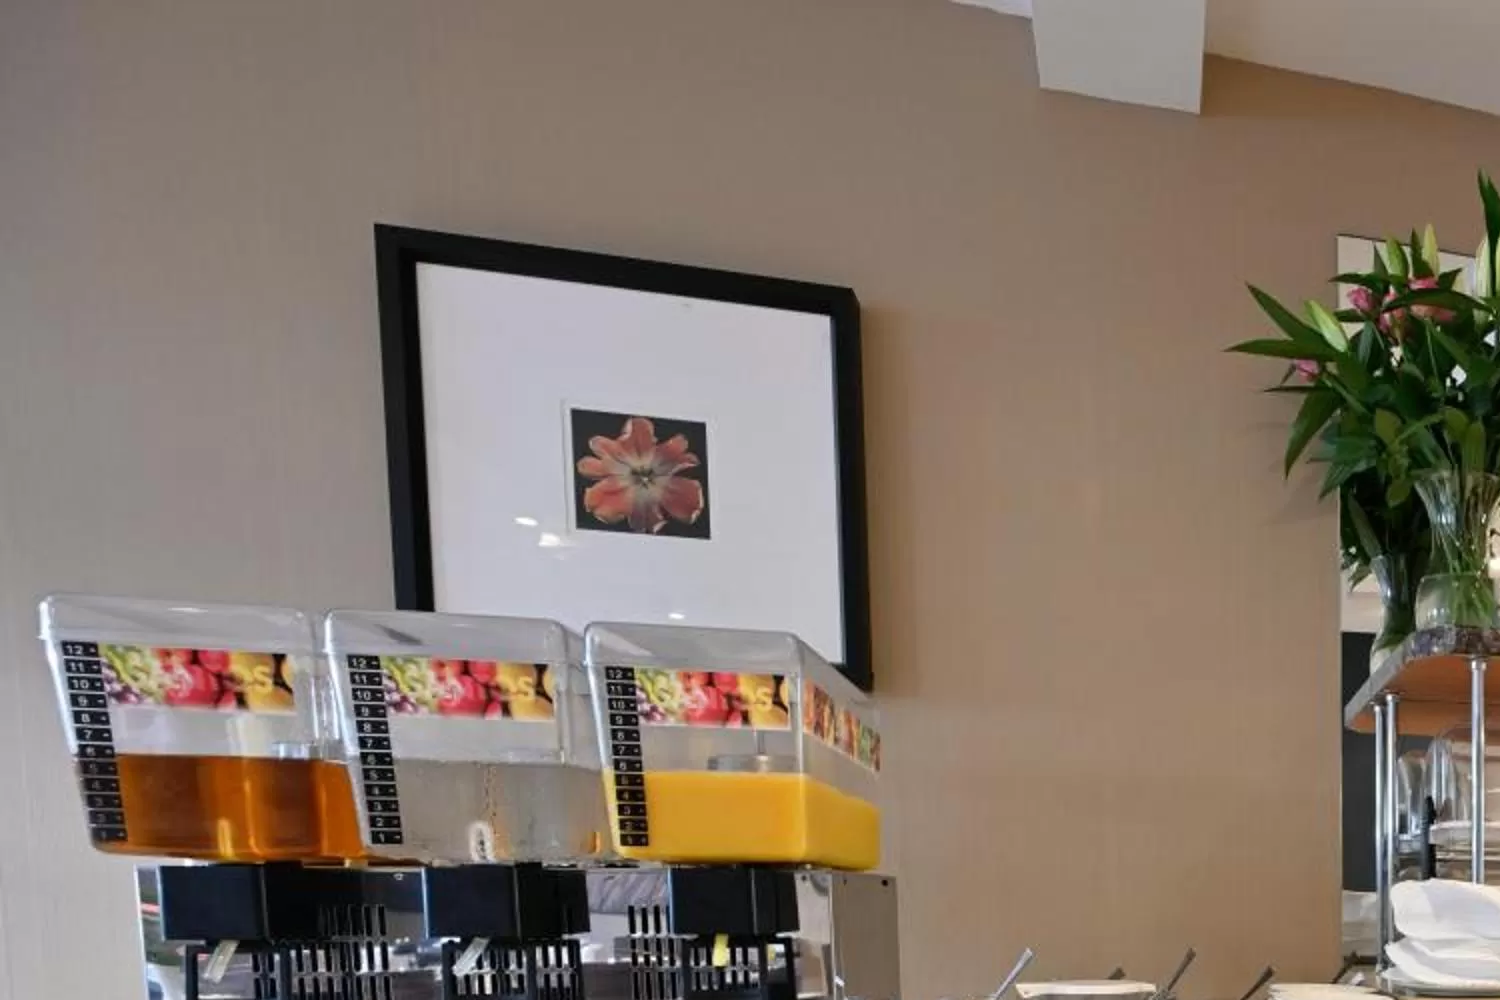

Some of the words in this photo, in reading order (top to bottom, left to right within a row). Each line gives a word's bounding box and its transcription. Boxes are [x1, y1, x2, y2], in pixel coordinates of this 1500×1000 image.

[65, 645, 84, 655] 12
[69, 662, 84, 672] 11
[351, 658, 367, 668] 12
[354, 674, 368, 684] 11
[607, 670, 623, 679] 12
[71, 679, 89, 689] 10
[609, 685, 623, 694] 11
[356, 690, 371, 700] 10
[78, 696, 88, 706] 9
[611, 701, 625, 710] 10
[81, 713, 91, 723] 8
[616, 716, 625, 725] 9
[363, 722, 372, 733] 8
[83, 730, 93, 740] 7
[365, 738, 374, 748] 7
